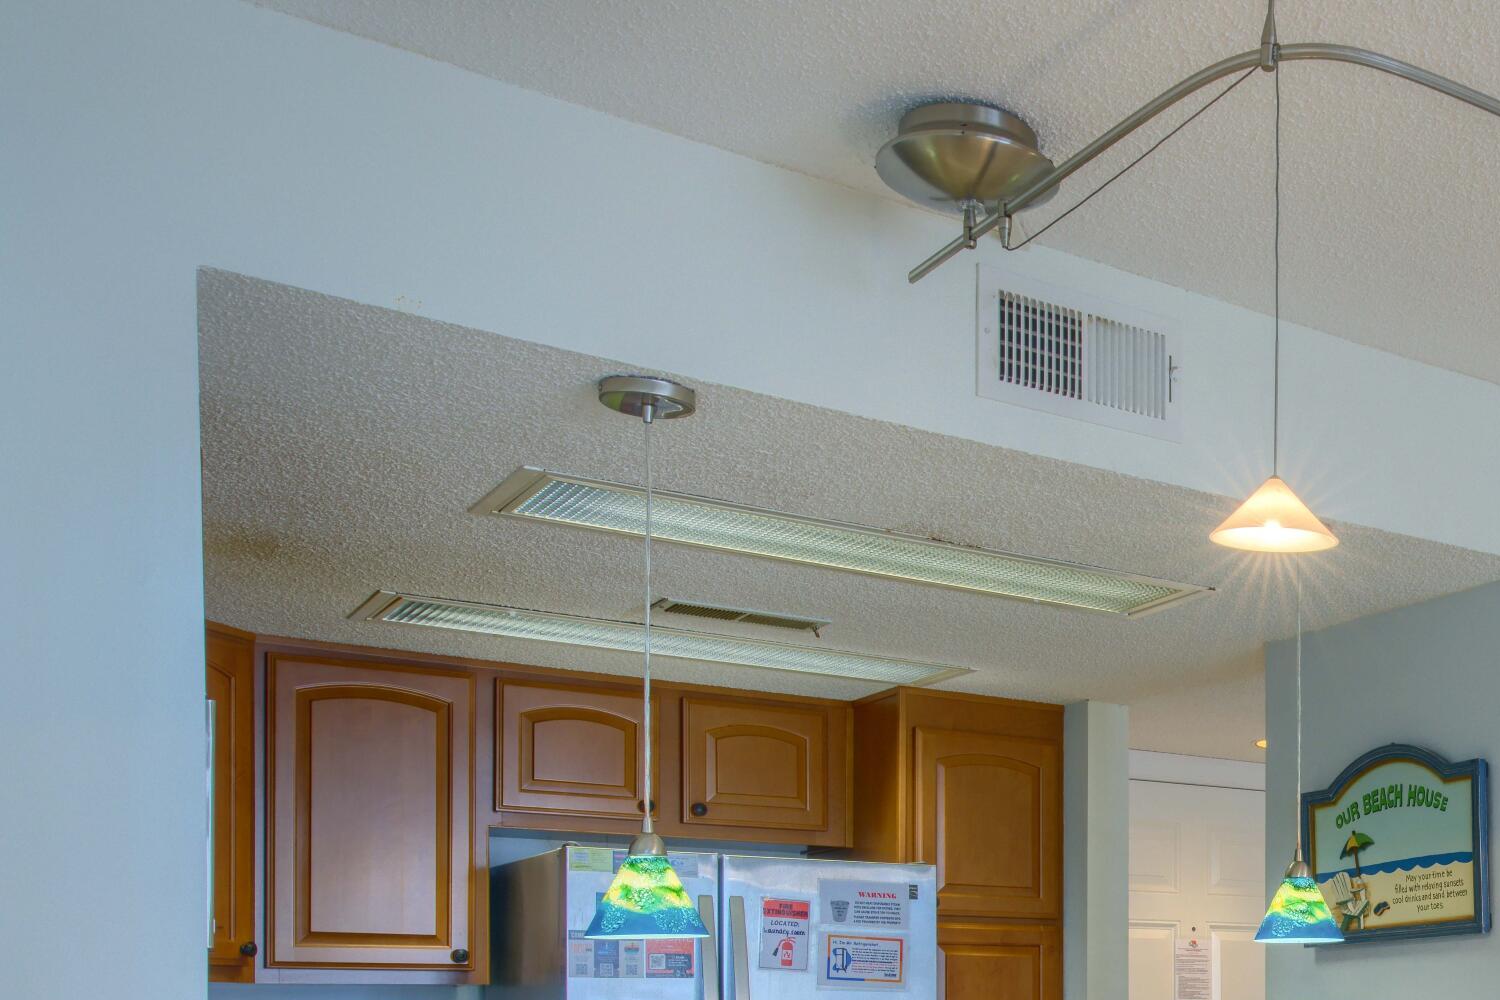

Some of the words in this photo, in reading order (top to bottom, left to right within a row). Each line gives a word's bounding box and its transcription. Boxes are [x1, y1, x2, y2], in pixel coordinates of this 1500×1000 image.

[1336, 802, 1360, 829] OUR
[1362, 784, 1403, 815] BEACH
[1407, 784, 1449, 812] HOUSE
[1406, 874, 1417, 883] May
[1418, 873, 1431, 883] your
[1432, 871, 1445, 879] time
[1395, 883, 1408, 894] filled
[1409, 882, 1421, 892] with
[1422, 881, 1443, 892] relaxing
[858, 891, 897, 899] WARNING
[1392, 896, 1404, 905] cool
[1405, 894, 1422, 903] drinks
[1422, 892, 1432, 901] and
[1432, 891, 1445, 900] sand
[1446, 889, 1468, 898] between
[1416, 903, 1430, 913] your
